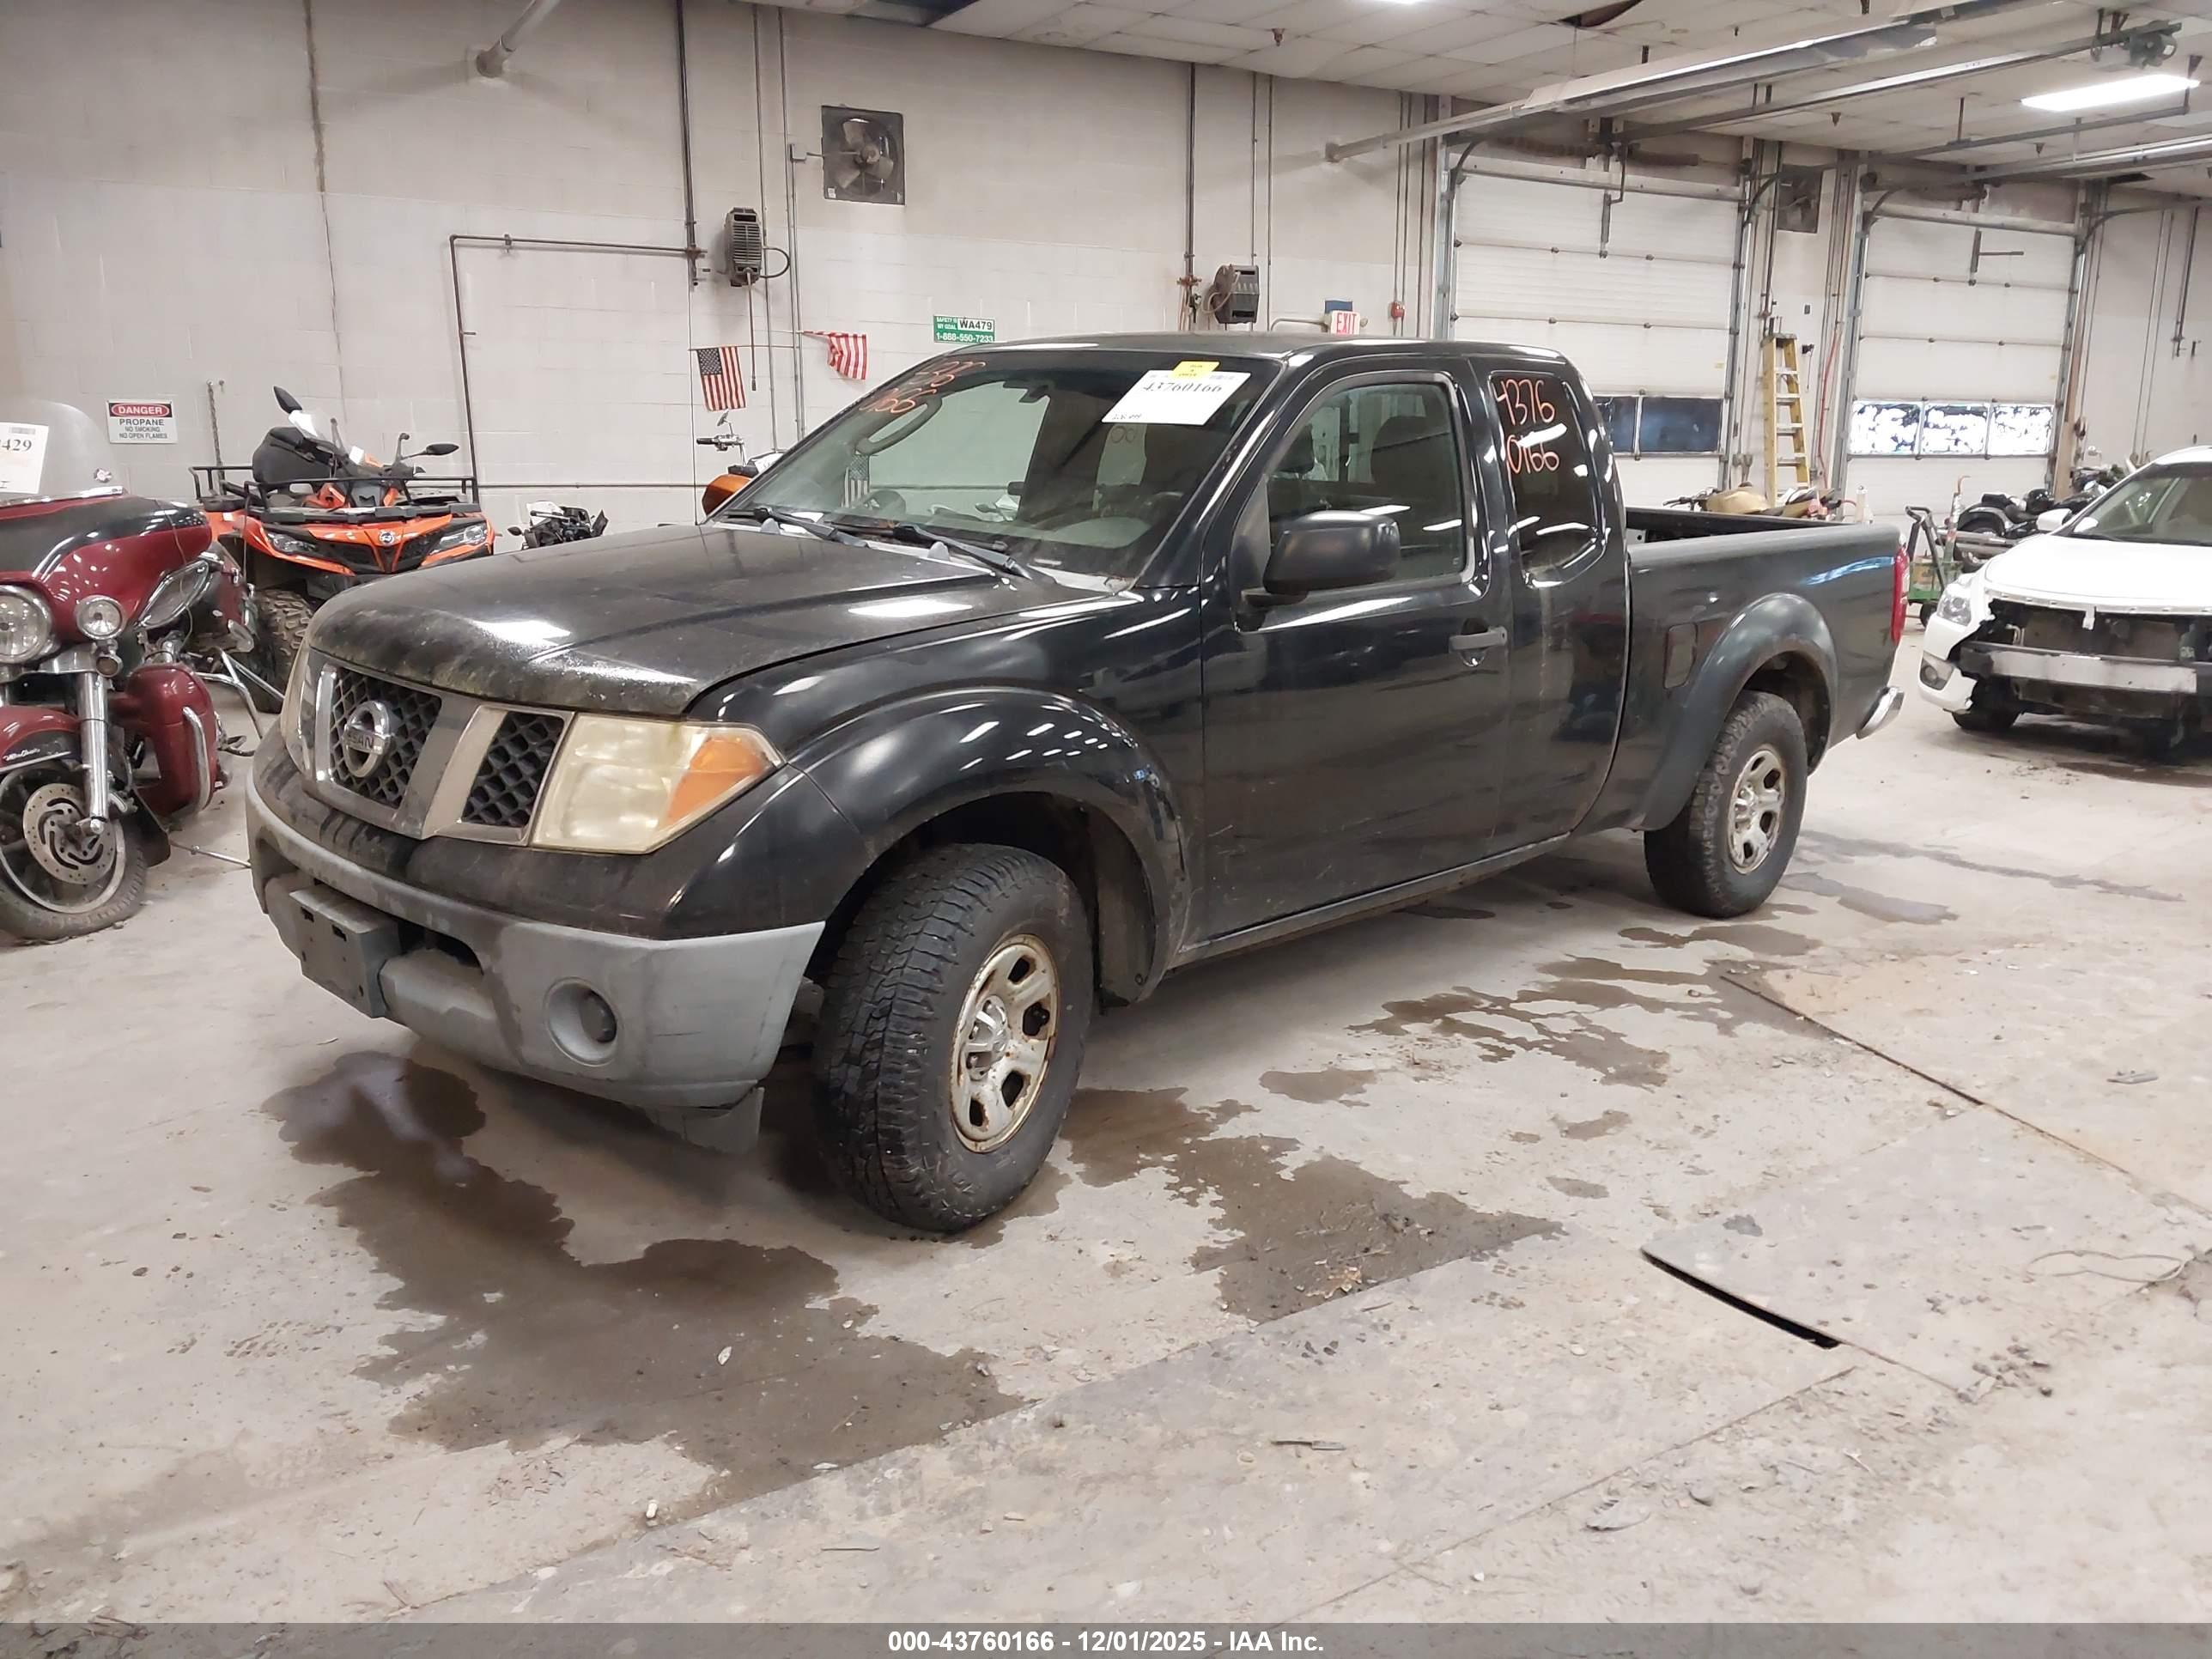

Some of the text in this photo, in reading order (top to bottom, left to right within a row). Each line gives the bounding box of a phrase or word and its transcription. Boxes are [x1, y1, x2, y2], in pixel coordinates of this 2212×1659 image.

[959, 319, 993, 330] WA479
[1337, 313, 1357, 334] EXIT
[1143, 382, 1223, 392] 43760166
[1492, 379, 1555, 425] 4376
[118, 406, 163, 415] DANGER
[0, 439, 32, 451] 429
